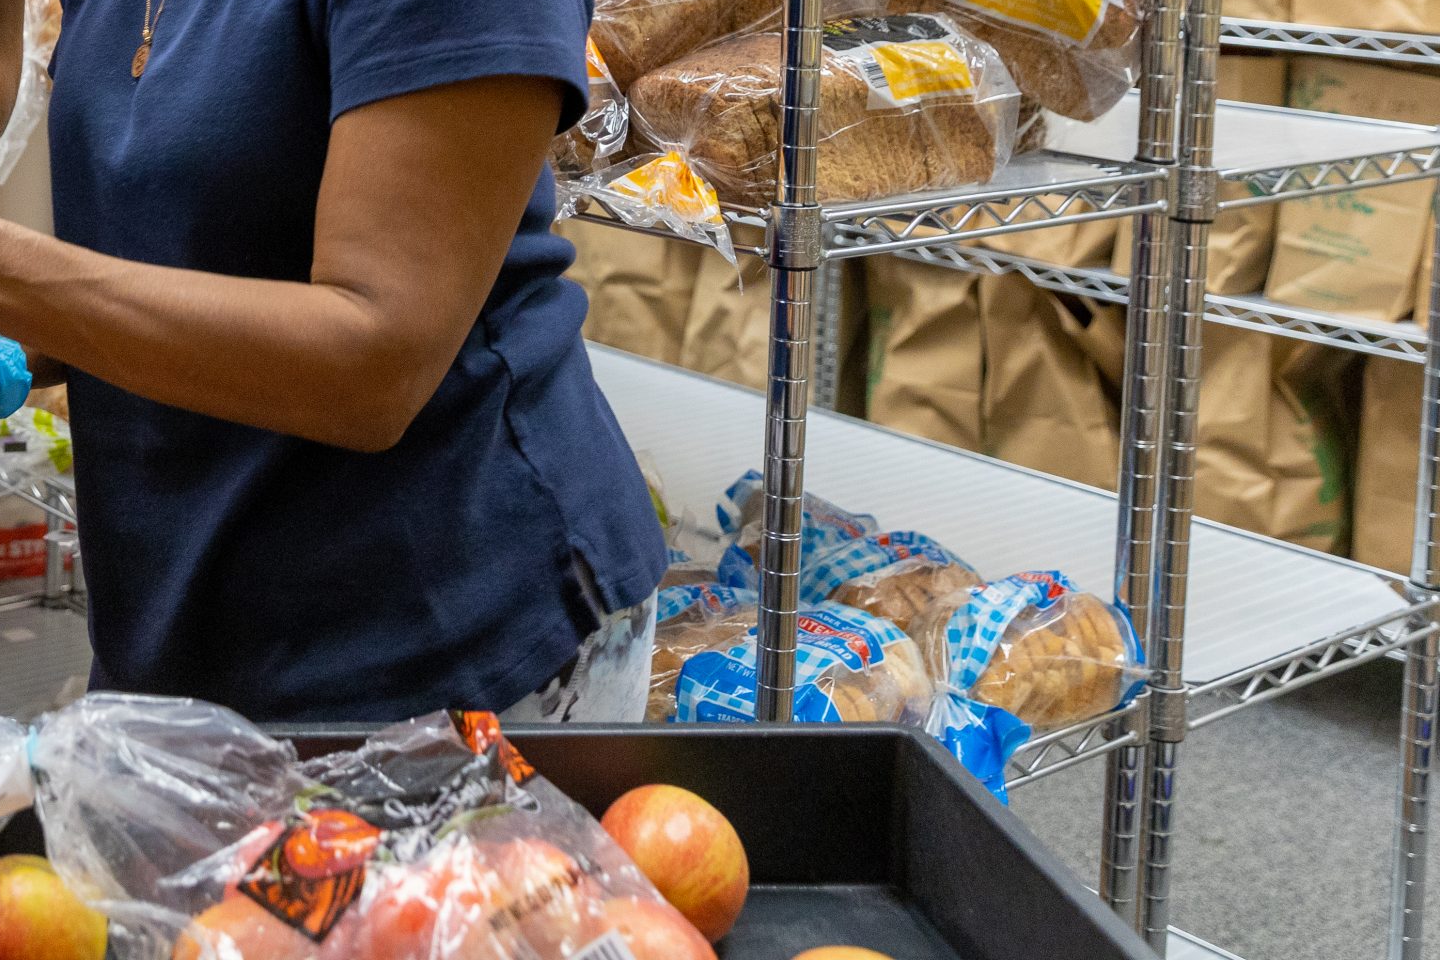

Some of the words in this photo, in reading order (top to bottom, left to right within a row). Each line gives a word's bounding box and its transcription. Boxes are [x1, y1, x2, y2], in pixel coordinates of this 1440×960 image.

[799, 618, 836, 636] UTEN
[813, 613, 840, 630] ADER
[726, 661, 744, 674] NET
